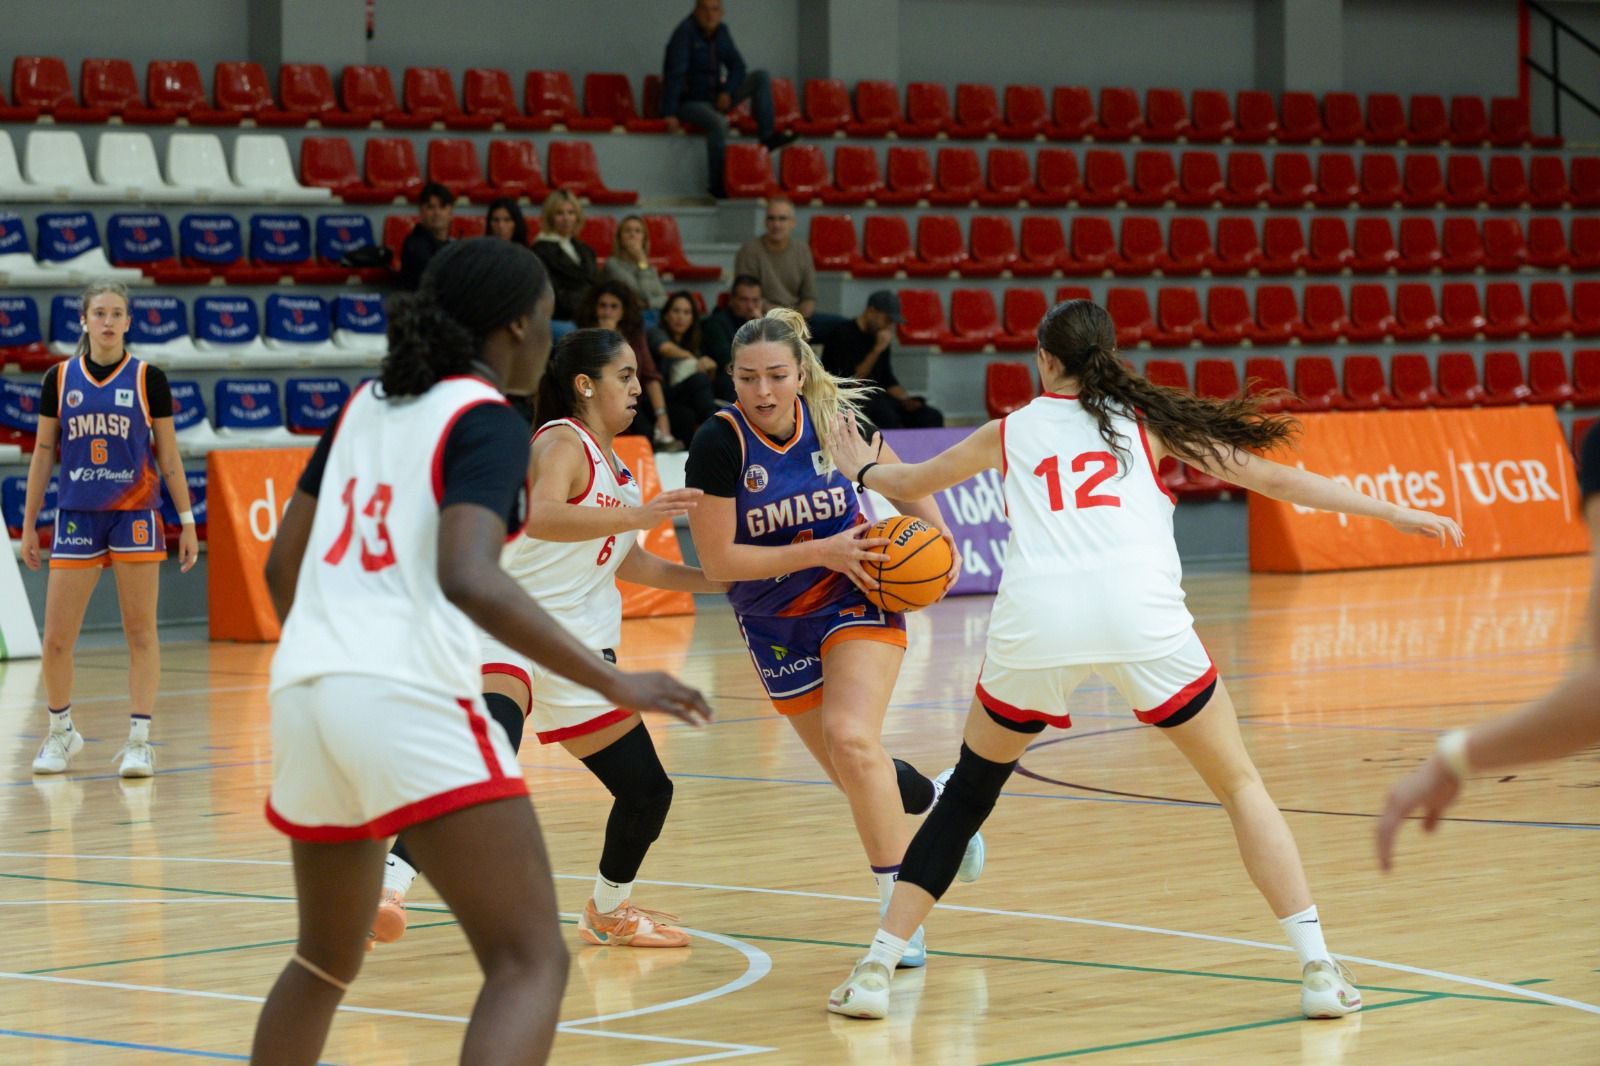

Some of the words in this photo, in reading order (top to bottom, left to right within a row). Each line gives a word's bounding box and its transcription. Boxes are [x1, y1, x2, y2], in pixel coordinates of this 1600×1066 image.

[91, 439, 108, 465] 6
[1033, 451, 1121, 512] 12
[1460, 460, 1560, 506] UGR
[746, 486, 847, 538] GMASB
[132, 519, 149, 545] 6
[596, 535, 616, 566] 6
[762, 655, 821, 679] PLAION
